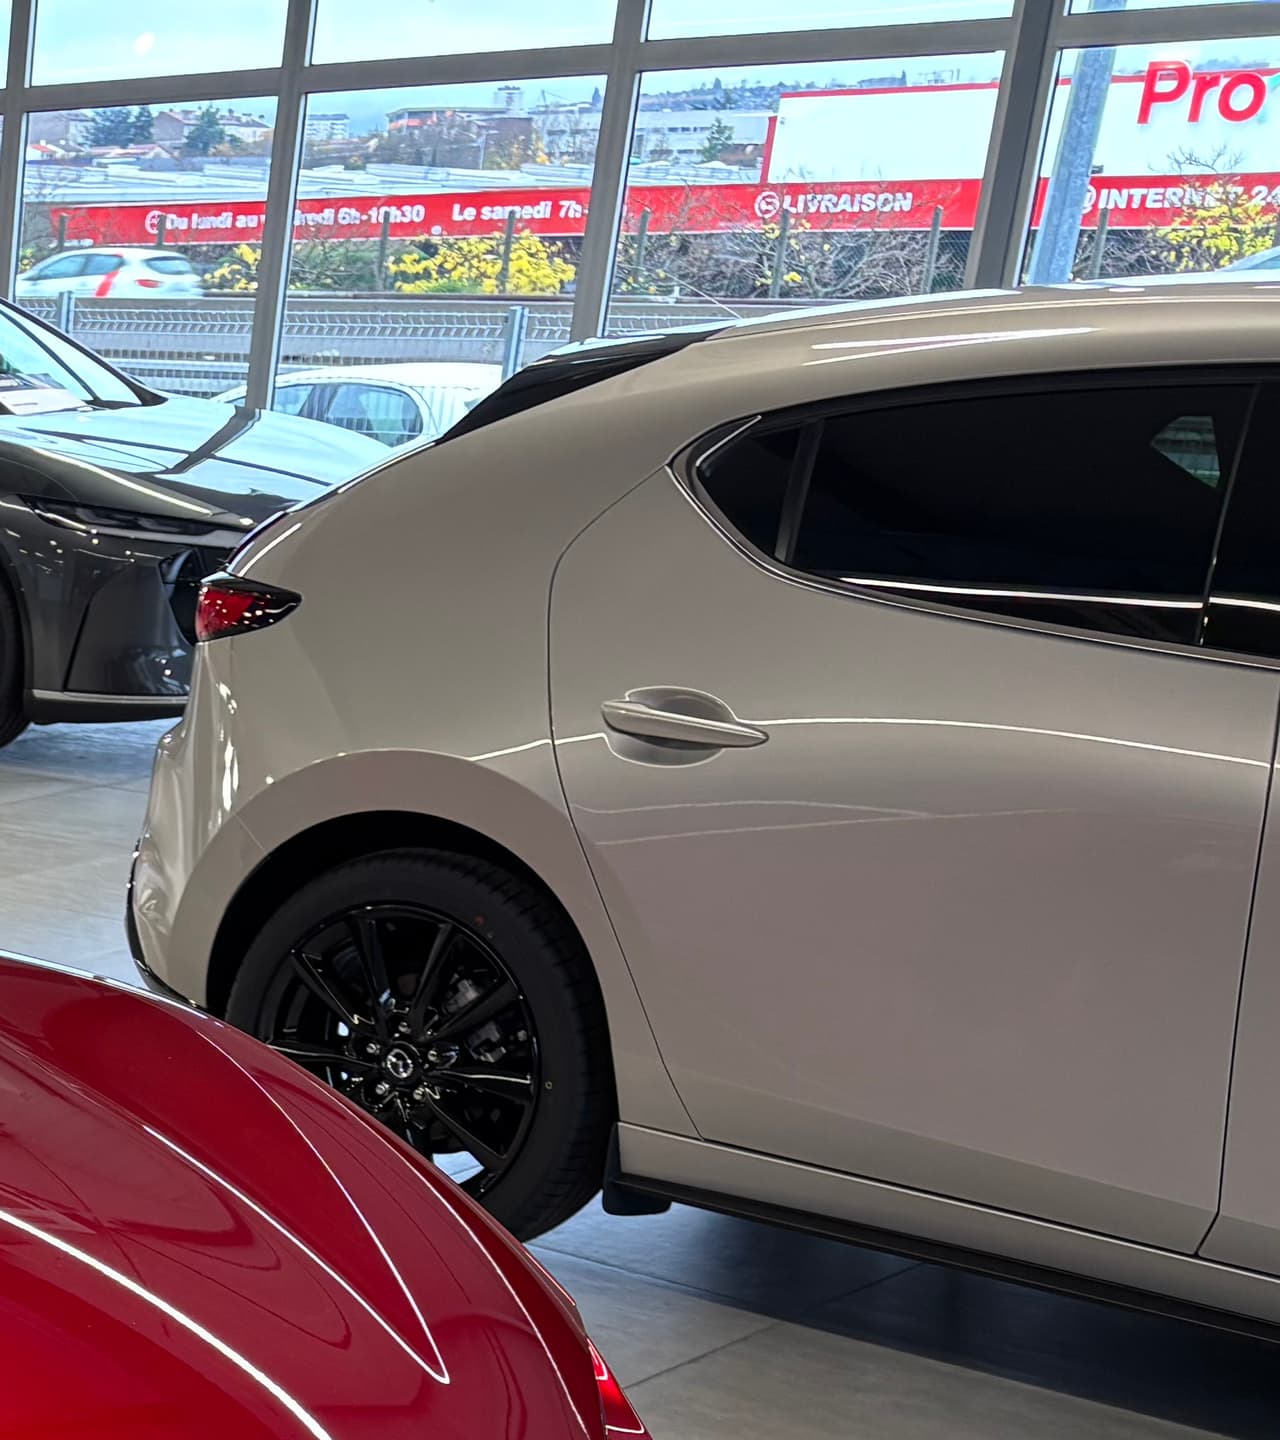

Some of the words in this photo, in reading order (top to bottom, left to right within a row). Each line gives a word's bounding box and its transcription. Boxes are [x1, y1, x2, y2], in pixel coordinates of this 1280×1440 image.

[1137, 60, 1268, 124] Pro
[452, 203, 476, 221] Le
[480, 200, 552, 220] samedi
[783, 192, 913, 213] LIVRAISON
[192, 212, 233, 230] lundi
[235, 214, 258, 229] au
